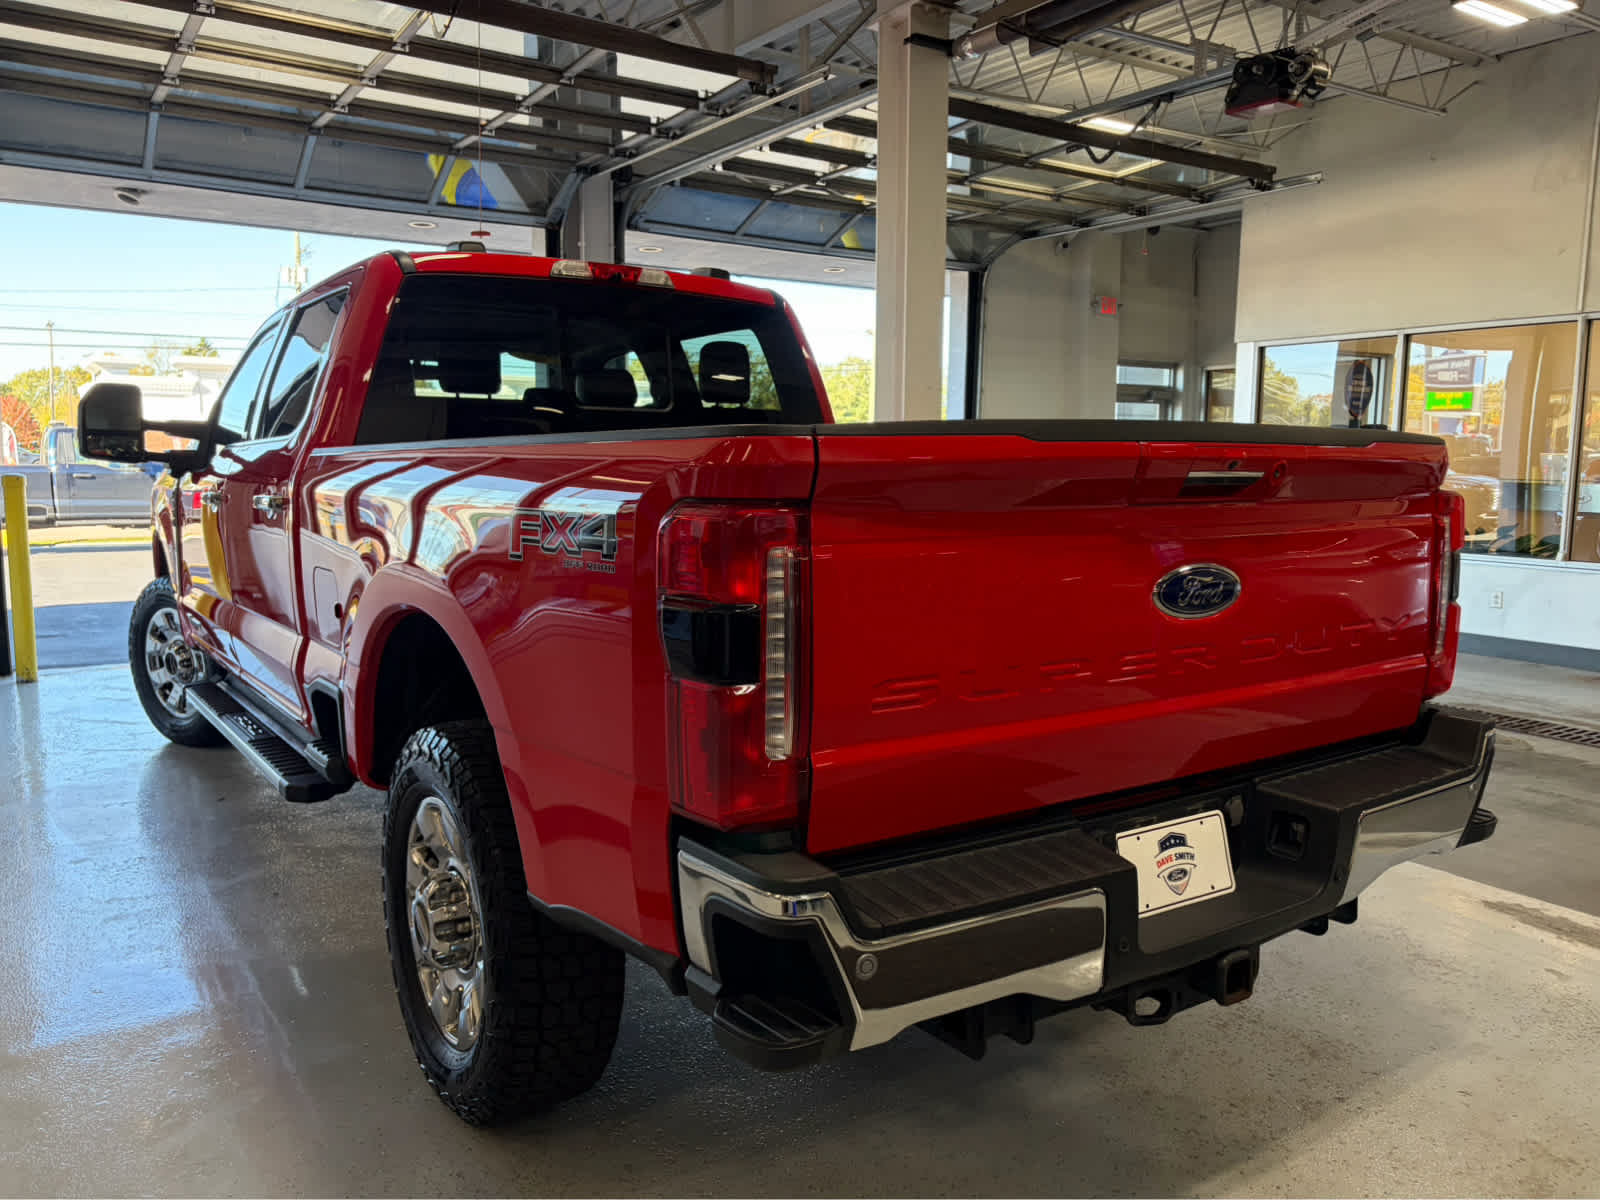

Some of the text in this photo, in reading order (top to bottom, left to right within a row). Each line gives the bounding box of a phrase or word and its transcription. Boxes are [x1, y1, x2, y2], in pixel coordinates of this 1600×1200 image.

[508, 507, 618, 562] FX4
[1156, 852, 1195, 869] DAVE SMITH
